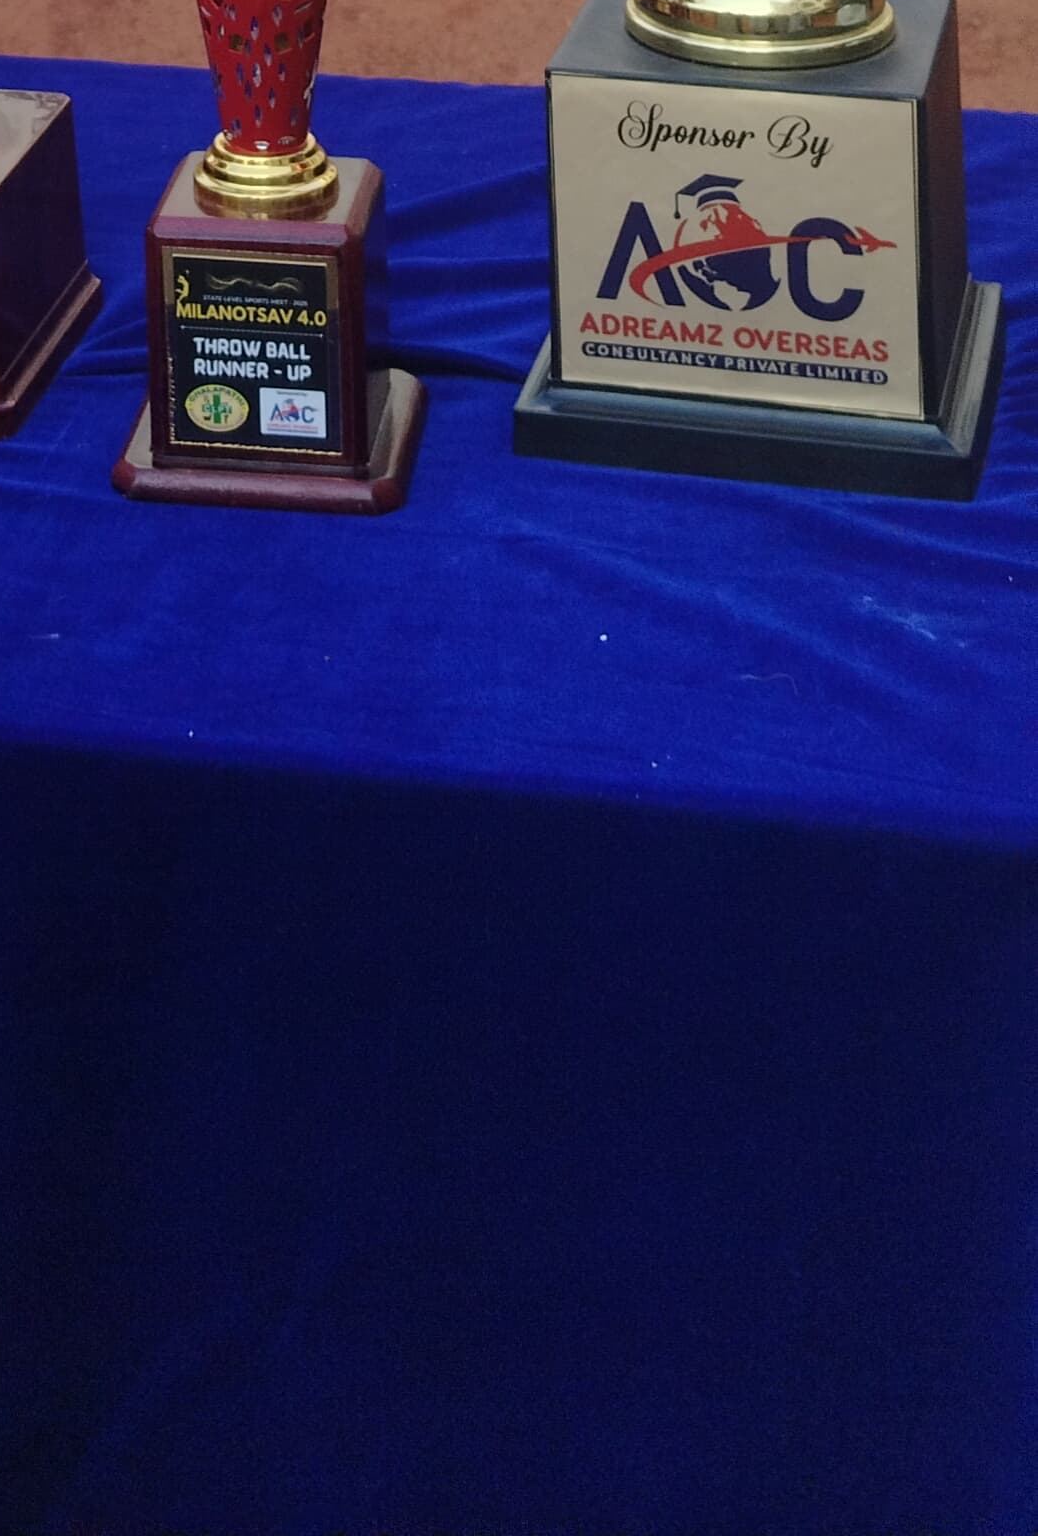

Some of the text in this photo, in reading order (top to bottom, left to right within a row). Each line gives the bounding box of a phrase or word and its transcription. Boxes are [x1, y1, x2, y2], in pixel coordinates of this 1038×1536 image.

[617, 99, 835, 168] Sponsor By
[176, 302, 327, 326] MILANOTSAV 4.0
[193, 336, 311, 360] THROW BALL
[579, 312, 889, 362] ADREAMZ OVERSEAS
[193, 358, 269, 379] RUNNER
[287, 364, 312, 381] UP
[586, 343, 886, 384] CONSULTANCY PRIVATE LIMITED
